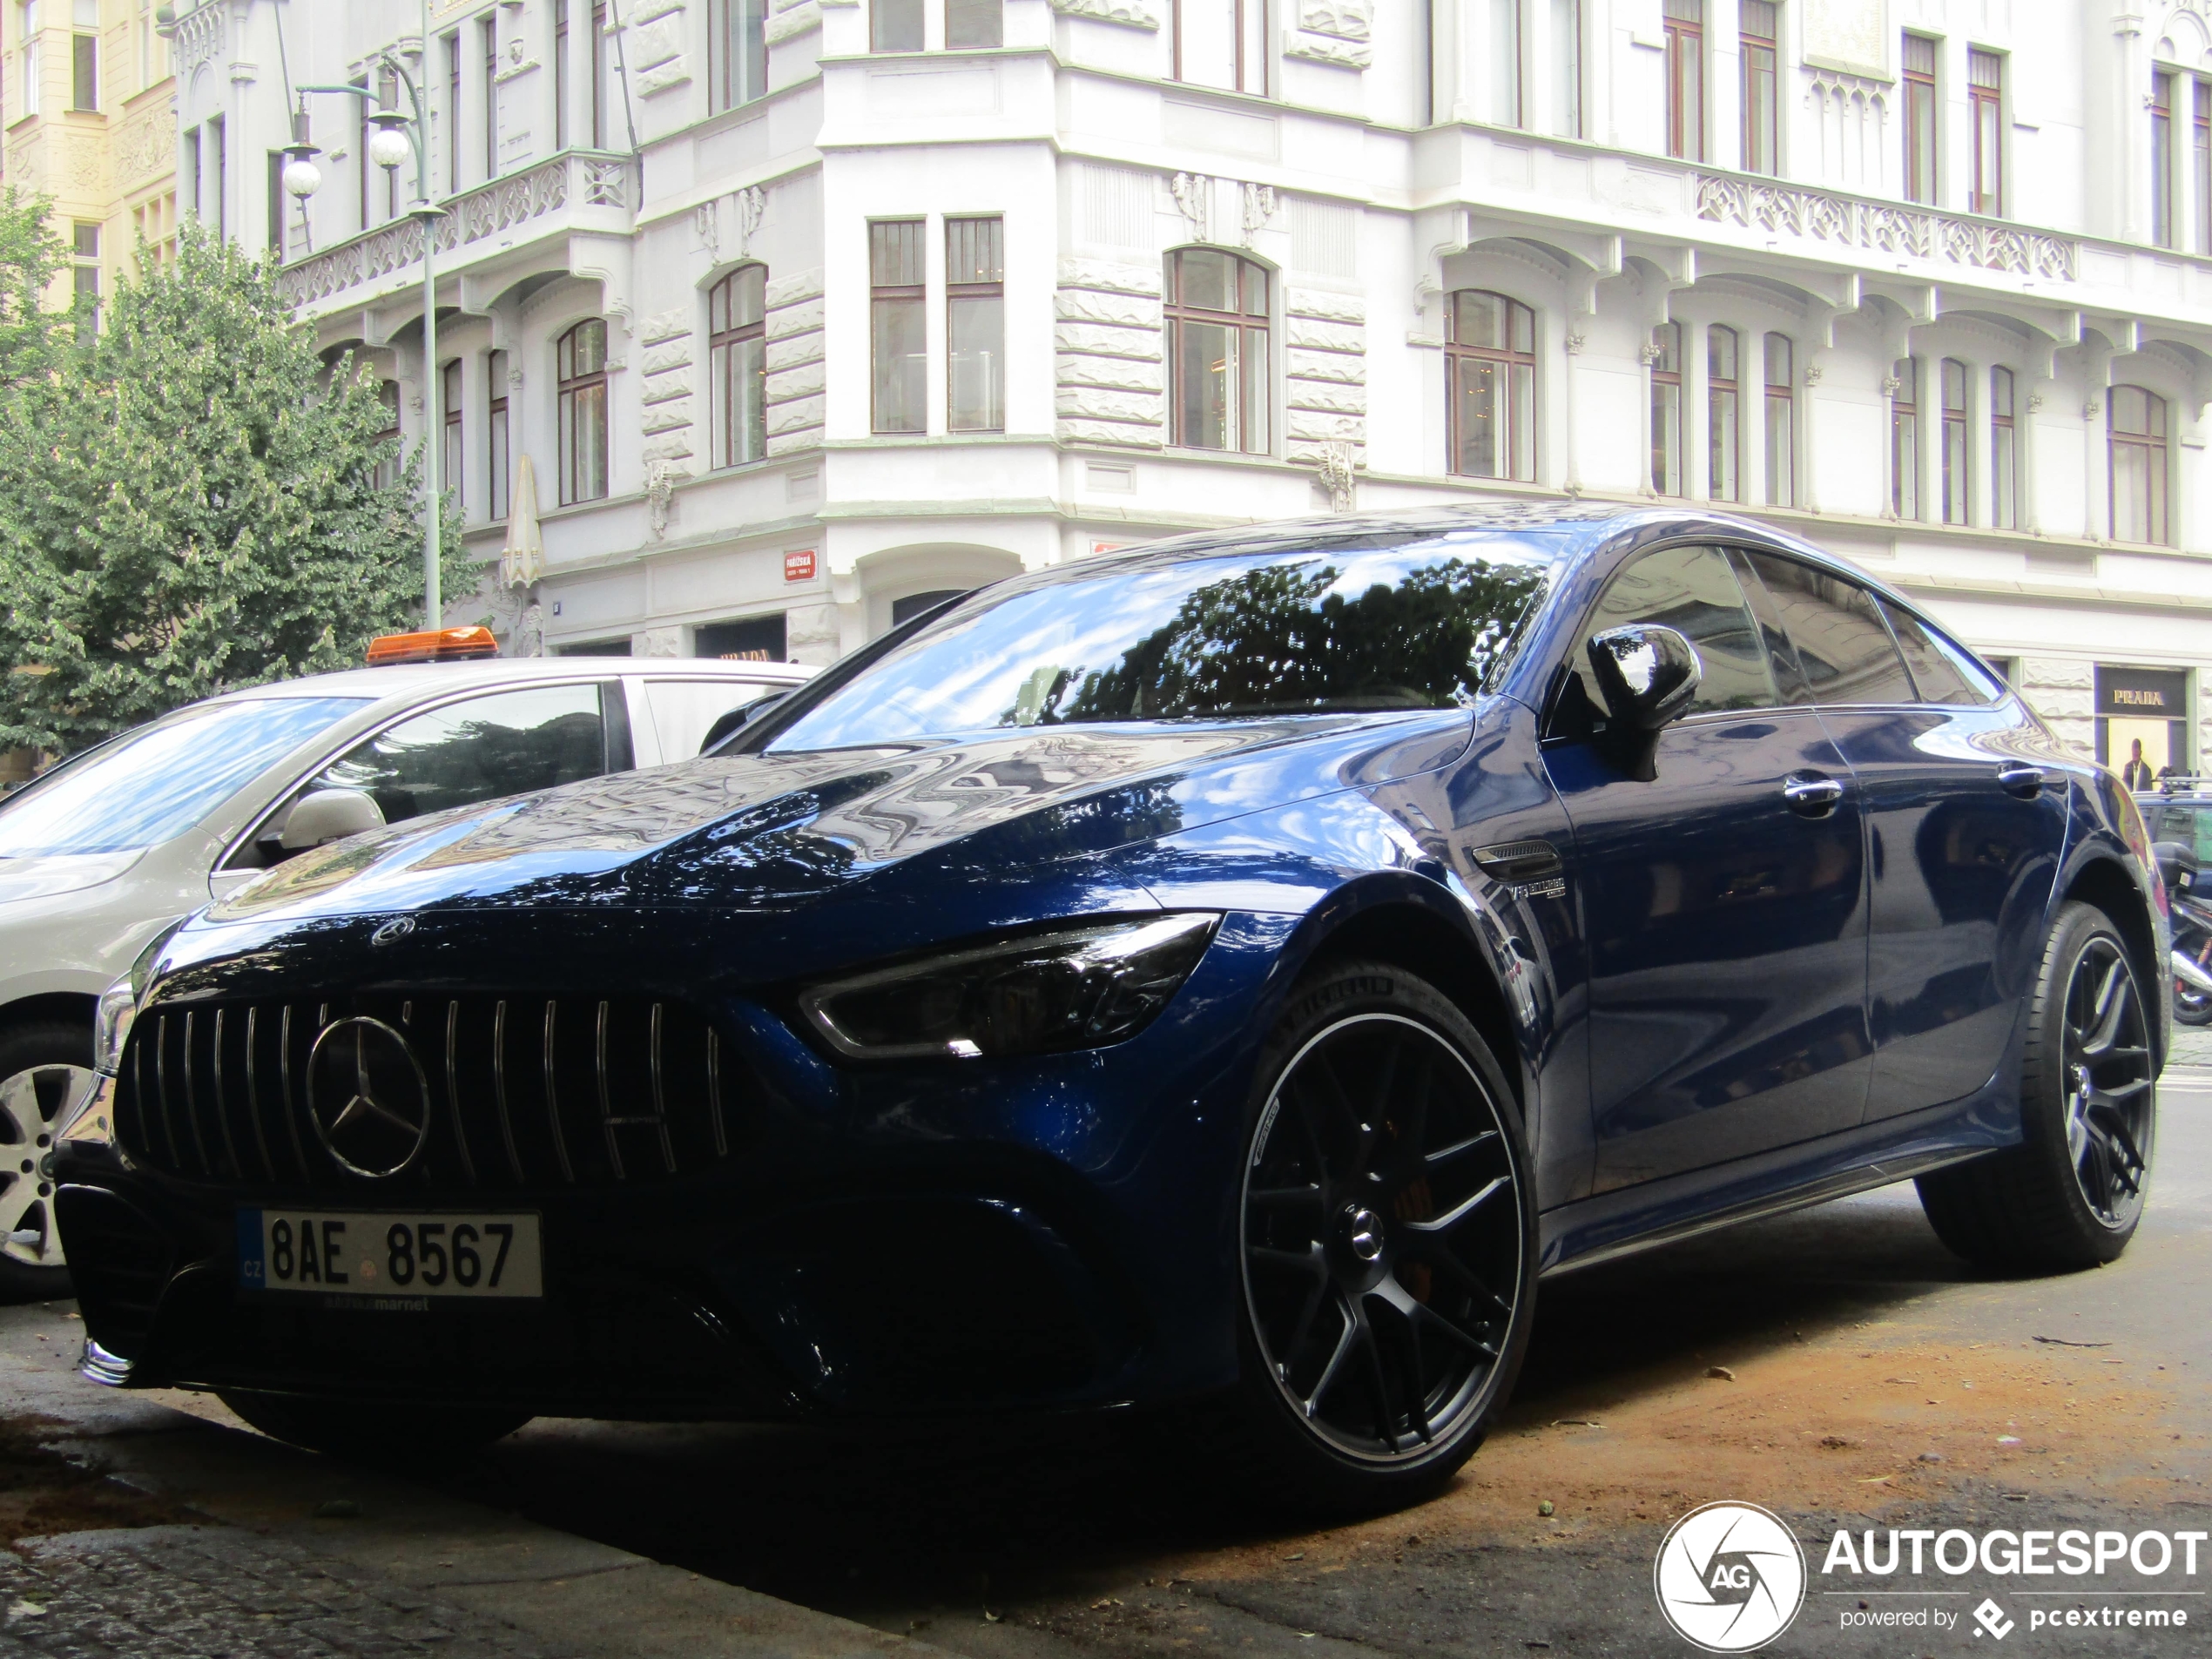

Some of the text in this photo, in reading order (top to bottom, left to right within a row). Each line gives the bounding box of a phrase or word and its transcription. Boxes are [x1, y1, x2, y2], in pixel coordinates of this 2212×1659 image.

[2114, 690, 2164, 705] PRADA
[272, 1217, 514, 1287] 8AE 8567
[244, 1260, 261, 1278] CZ
